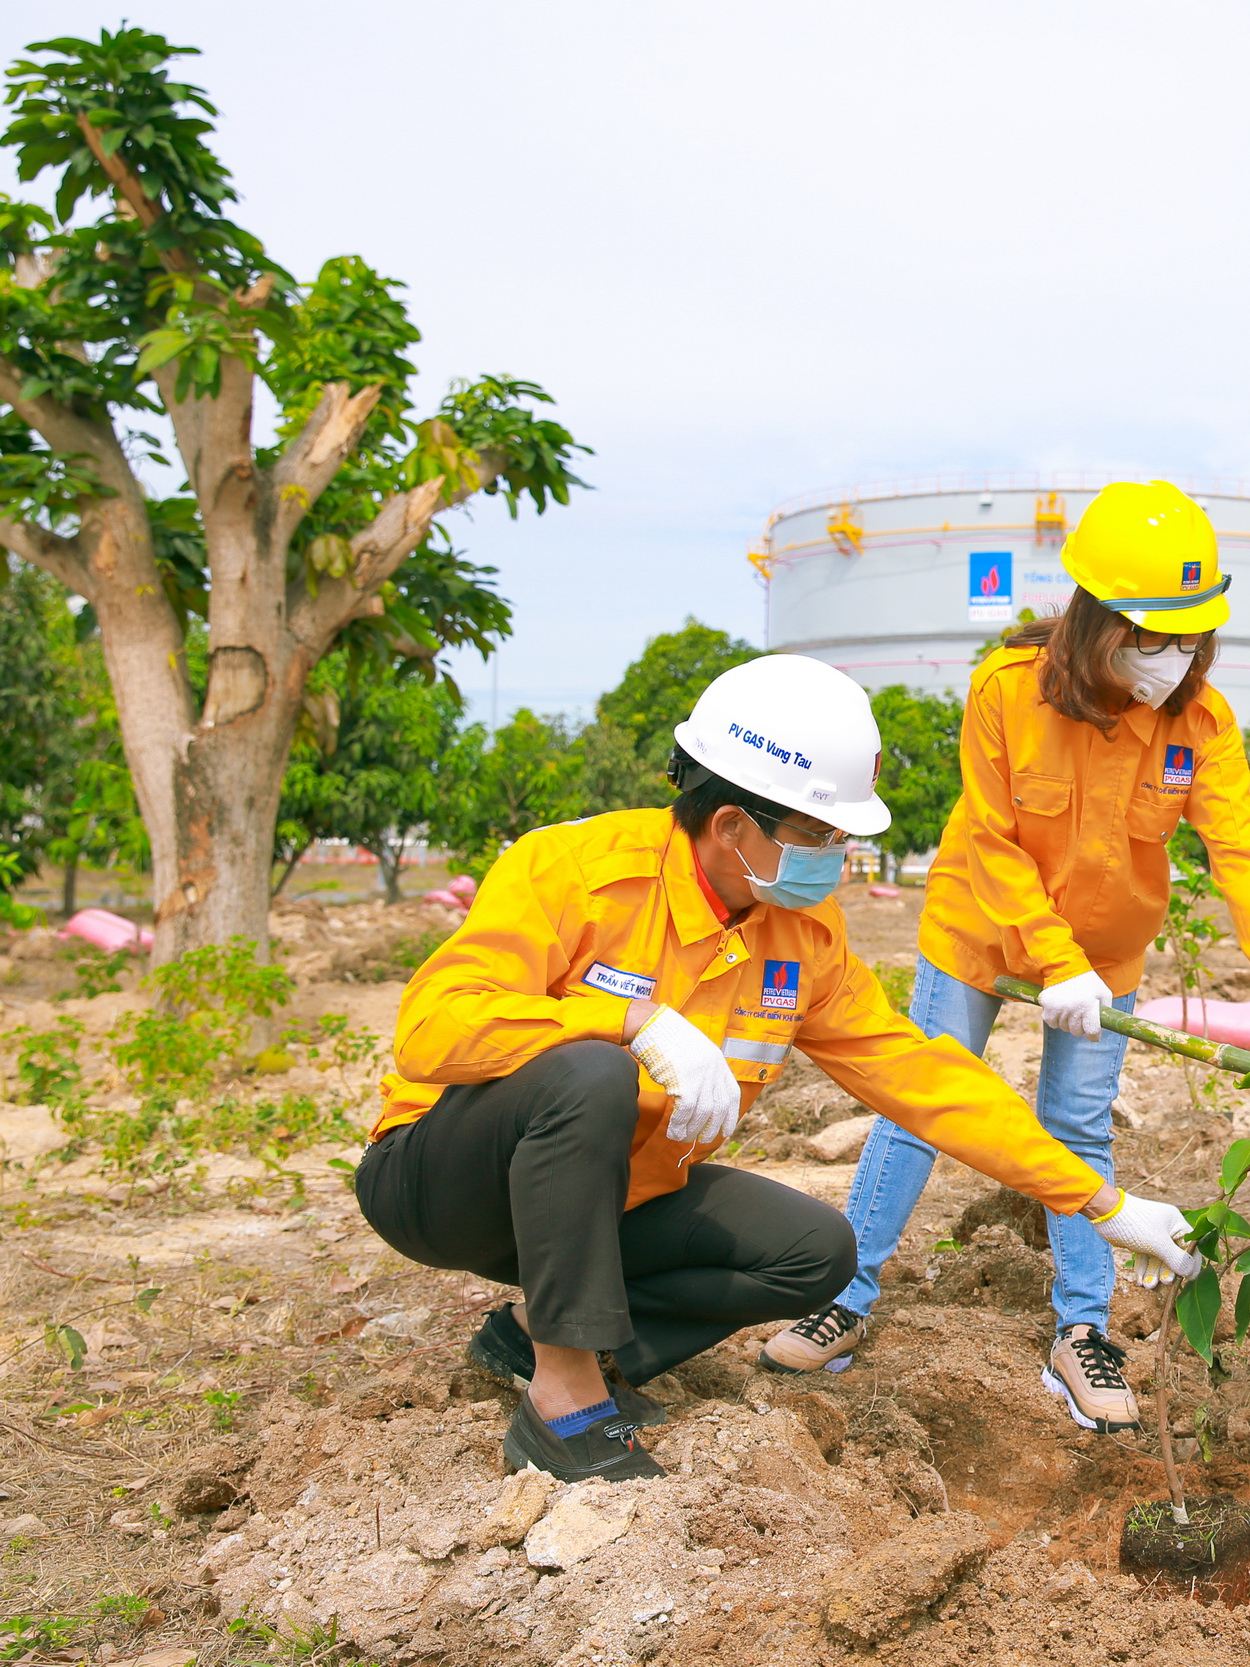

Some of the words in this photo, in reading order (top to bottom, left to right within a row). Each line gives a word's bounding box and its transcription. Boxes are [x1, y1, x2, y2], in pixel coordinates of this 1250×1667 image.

[728, 722, 744, 738] PV
[742, 730, 765, 749] GAS
[766, 740, 791, 764] Vung
[793, 752, 813, 770] Tau
[812, 790, 830, 801] KVT
[763, 997, 776, 1005] PV
[775, 998, 795, 1007] GAS
